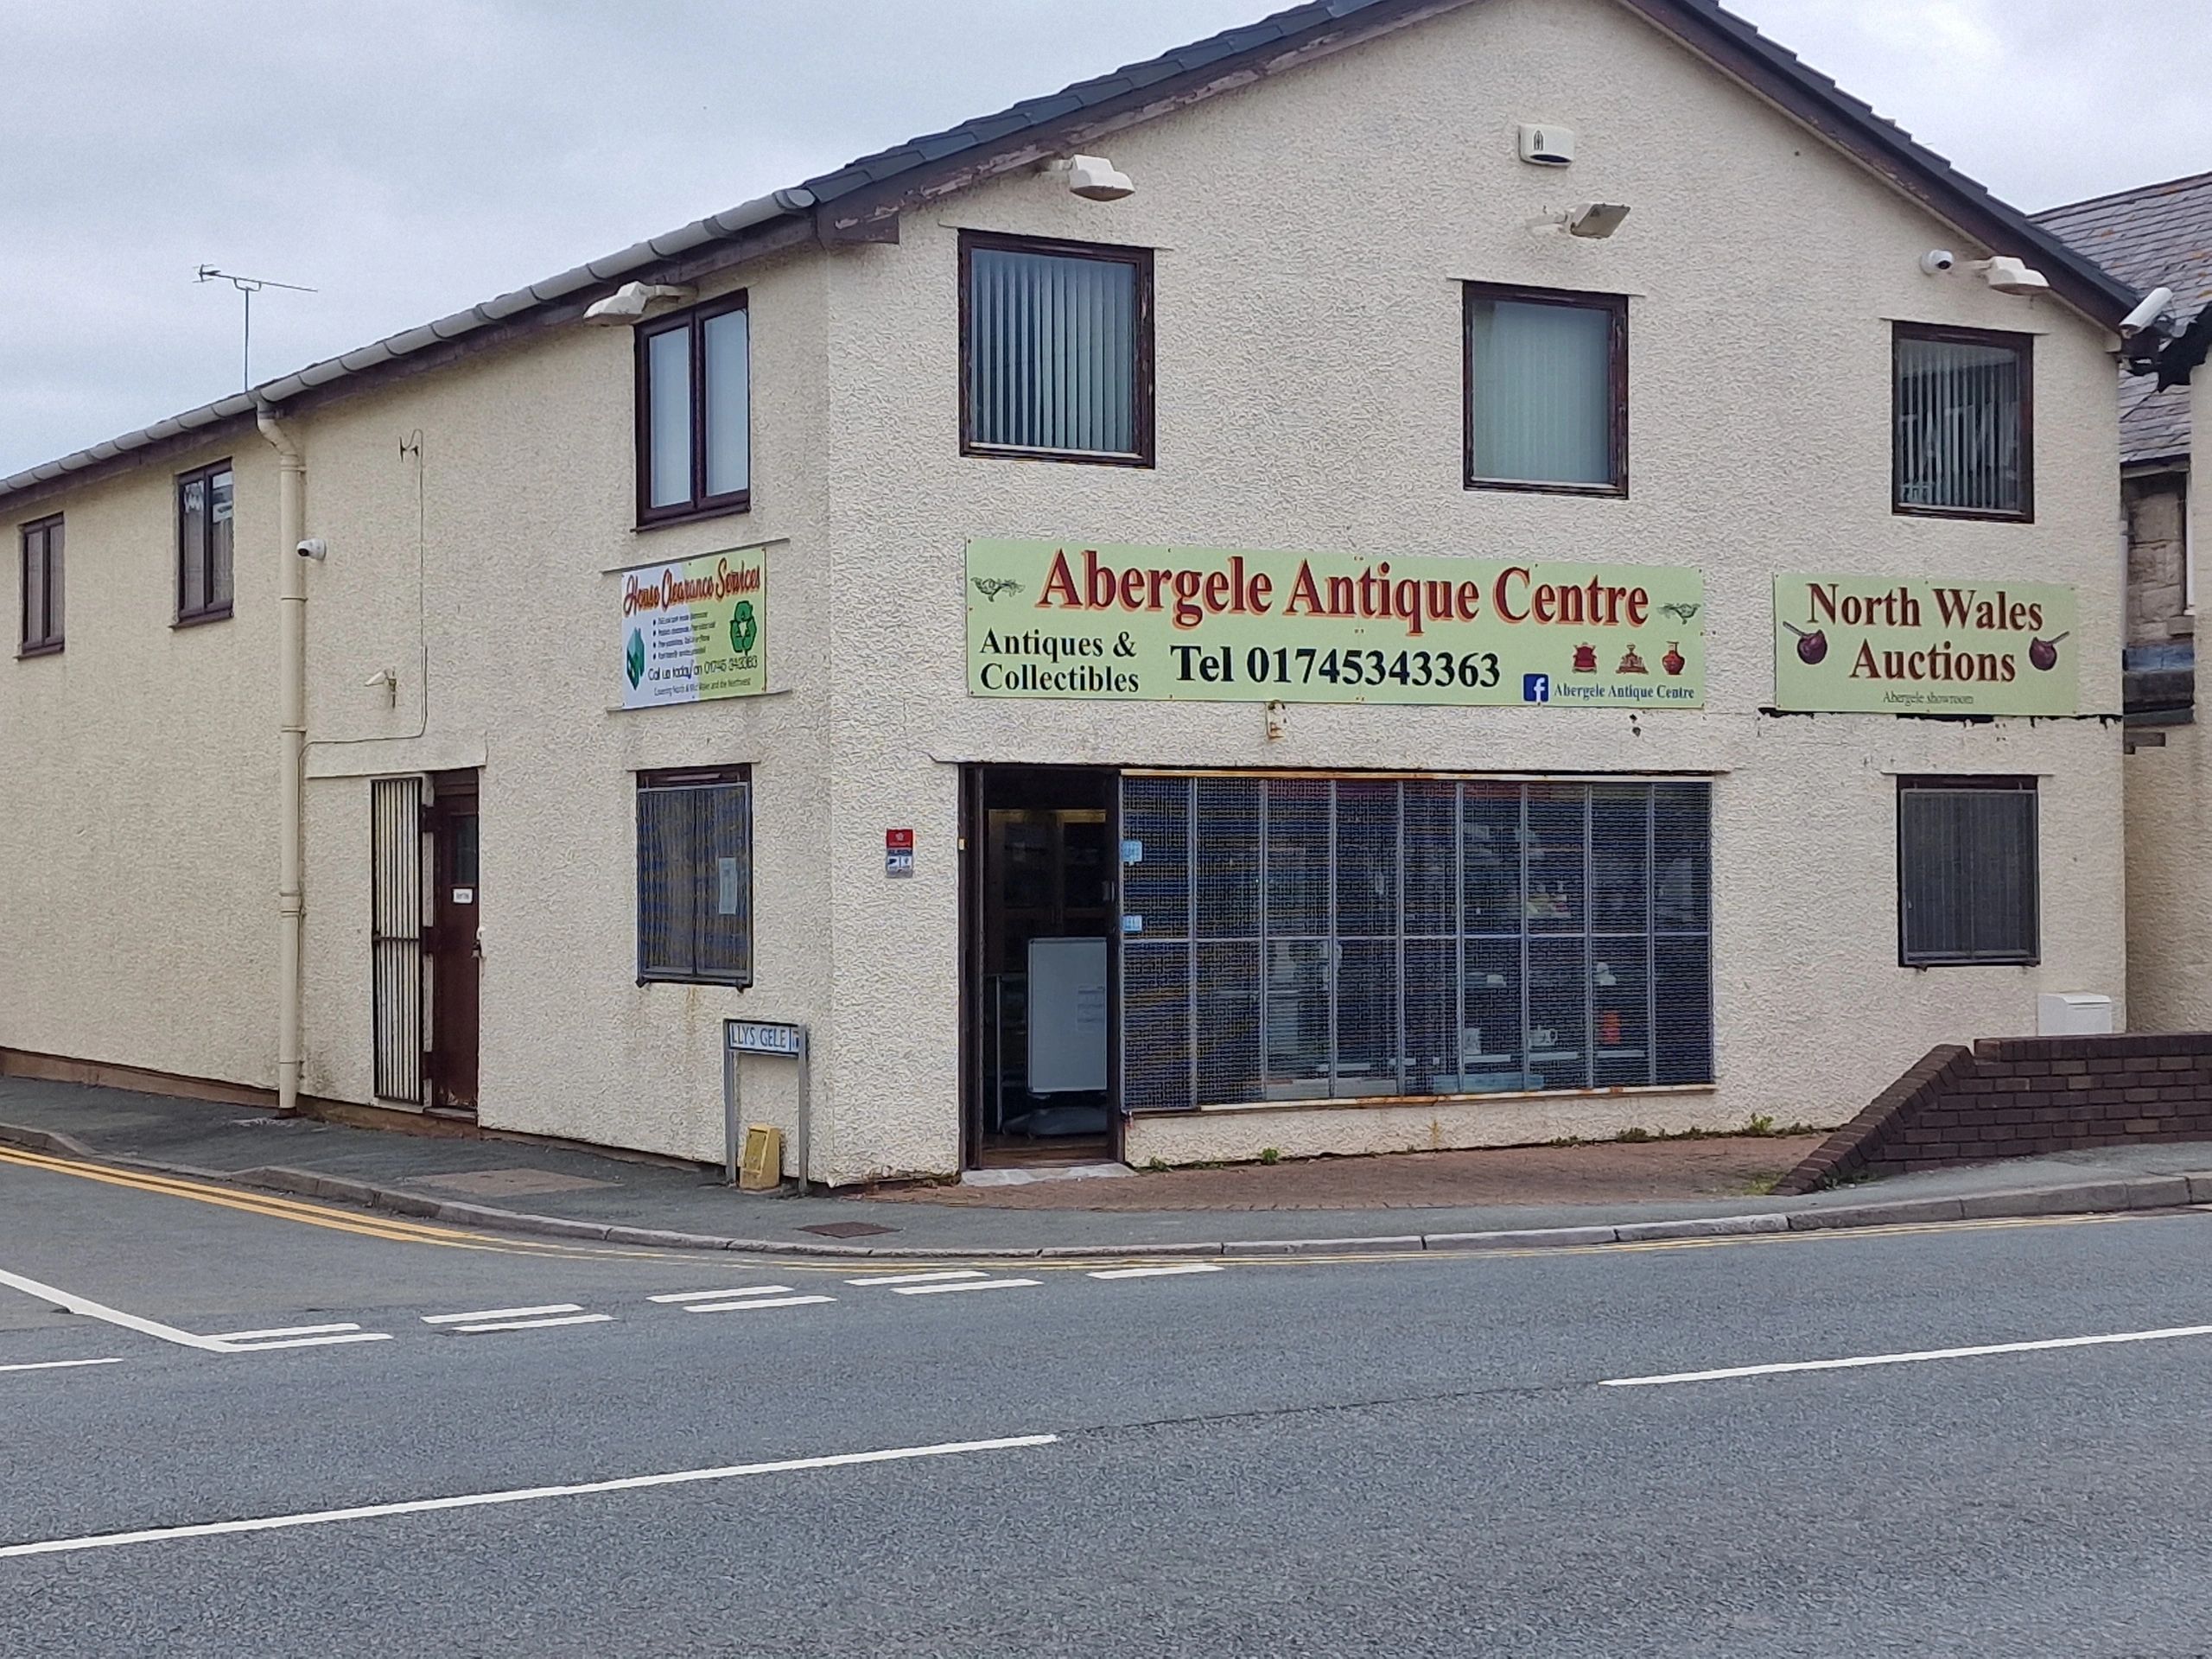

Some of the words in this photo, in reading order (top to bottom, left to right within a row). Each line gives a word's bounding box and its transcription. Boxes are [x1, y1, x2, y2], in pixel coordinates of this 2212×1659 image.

[624, 574, 659, 616] House
[662, 568, 714, 612] Clearance
[715, 557, 760, 601] Services
[1034, 548, 1272, 630] Abergele
[1282, 558, 1479, 636] Antique
[1493, 566, 1649, 627] Centre
[1807, 582, 1920, 627] North
[1934, 588, 2043, 631] Wales
[980, 628, 1103, 663] Antiques
[1113, 632, 1136, 657] &
[1849, 639, 2016, 683] Auctions
[980, 663, 1139, 693] Collectibles
[1170, 645, 1234, 682] Tel
[1247, 646, 1500, 687] 01745343363
[1554, 683, 1605, 700] Abergele
[1608, 684, 1653, 701] Antique
[1656, 685, 1694, 699] Centre
[1883, 690, 1925, 707] Abergele
[1927, 691, 1974, 704] showroom
[732, 1024, 755, 1046] LLYS
[760, 1027, 786, 1048] GELE
